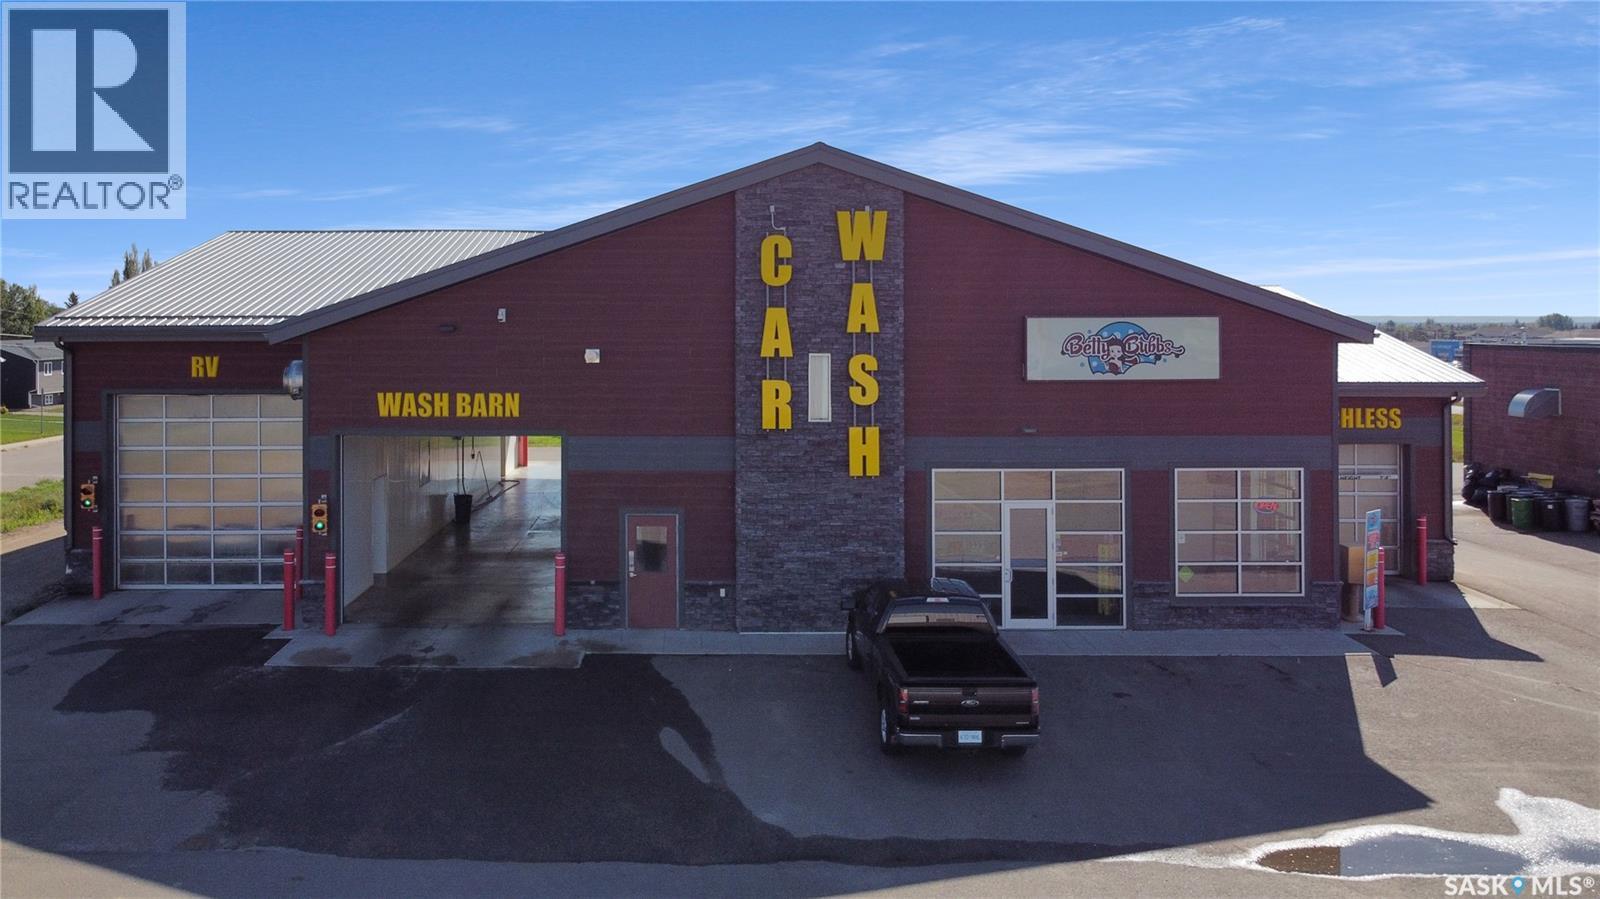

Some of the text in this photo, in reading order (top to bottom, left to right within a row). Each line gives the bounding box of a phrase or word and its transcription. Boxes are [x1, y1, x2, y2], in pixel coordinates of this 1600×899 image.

[760, 234, 793, 430] CAR
[836, 210, 888, 477] WASH
[1063, 333, 1184, 359] Betty Bubbs
[191, 356, 219, 378] RV
[377, 392, 520, 417] WASH BARN
